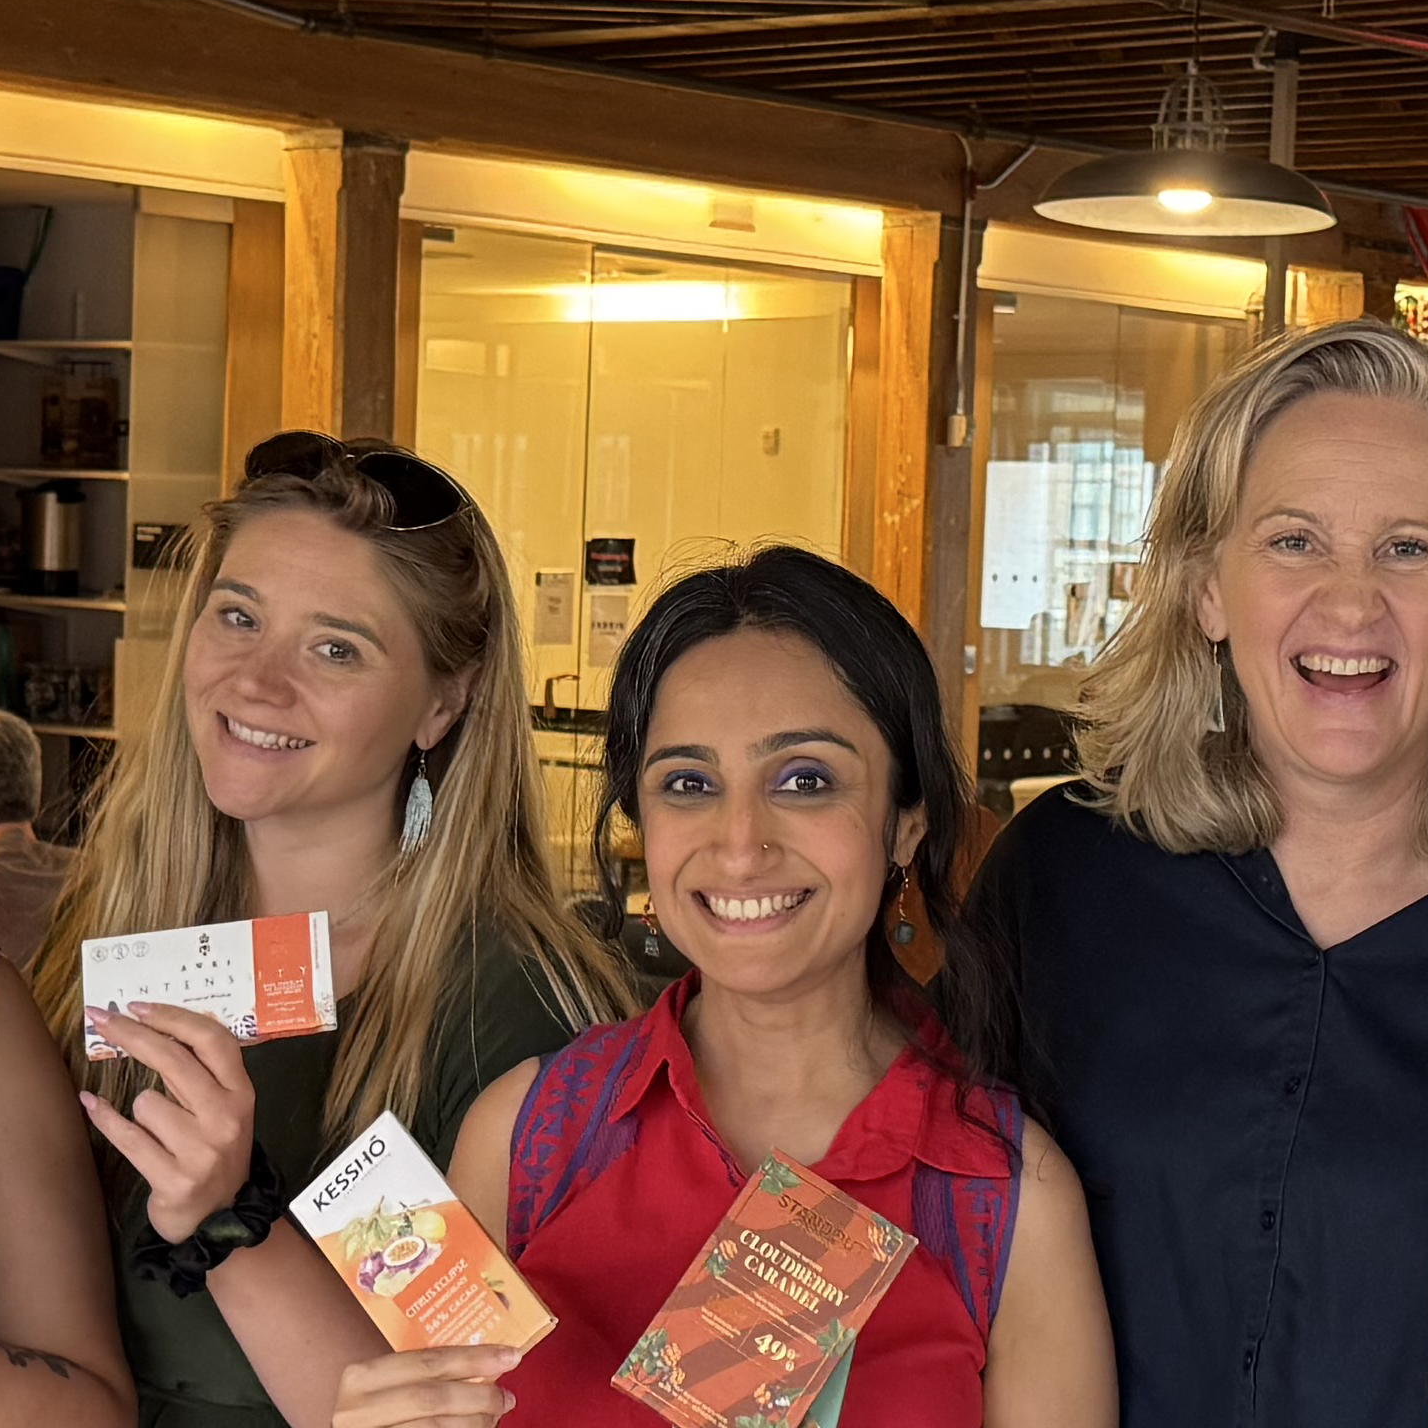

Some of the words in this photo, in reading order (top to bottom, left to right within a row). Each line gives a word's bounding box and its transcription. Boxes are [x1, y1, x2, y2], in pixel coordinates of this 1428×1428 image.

[739, 1229, 850, 1307] CLOUDBERRY
[744, 1254, 820, 1315] CARAMEL
[754, 1333, 797, 1372] 49%
